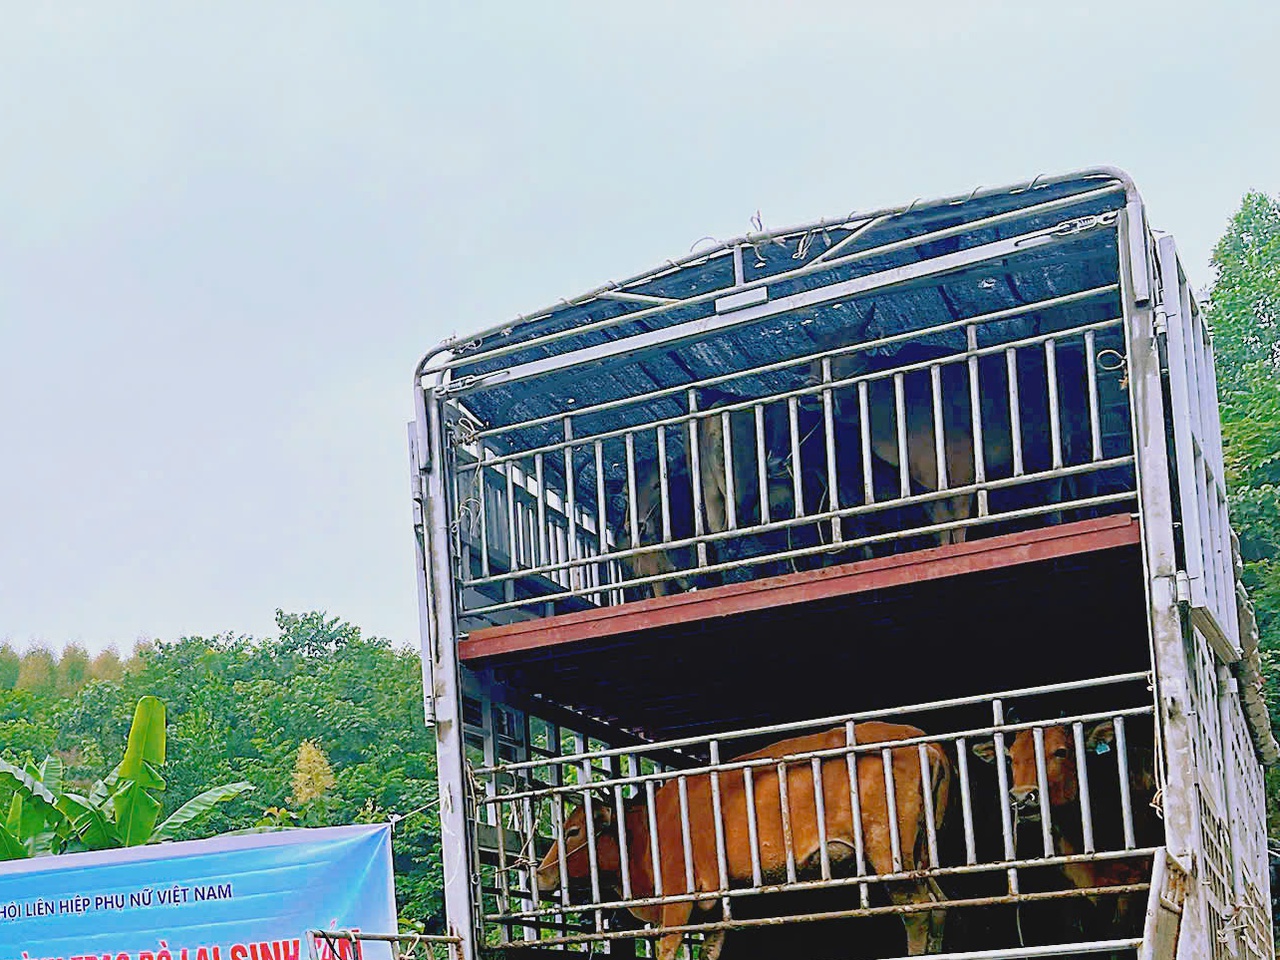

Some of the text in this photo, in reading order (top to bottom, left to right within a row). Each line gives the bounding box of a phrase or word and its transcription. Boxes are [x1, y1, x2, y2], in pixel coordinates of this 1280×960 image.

[25, 898, 55, 917] LIÊN
[59, 895, 90, 915] HIỆP
[95, 894, 125, 913] PHỤ
[130, 887, 153, 907] NỮ
[157, 885, 189, 907] VIỆT
[194, 883, 233, 902] NAM
